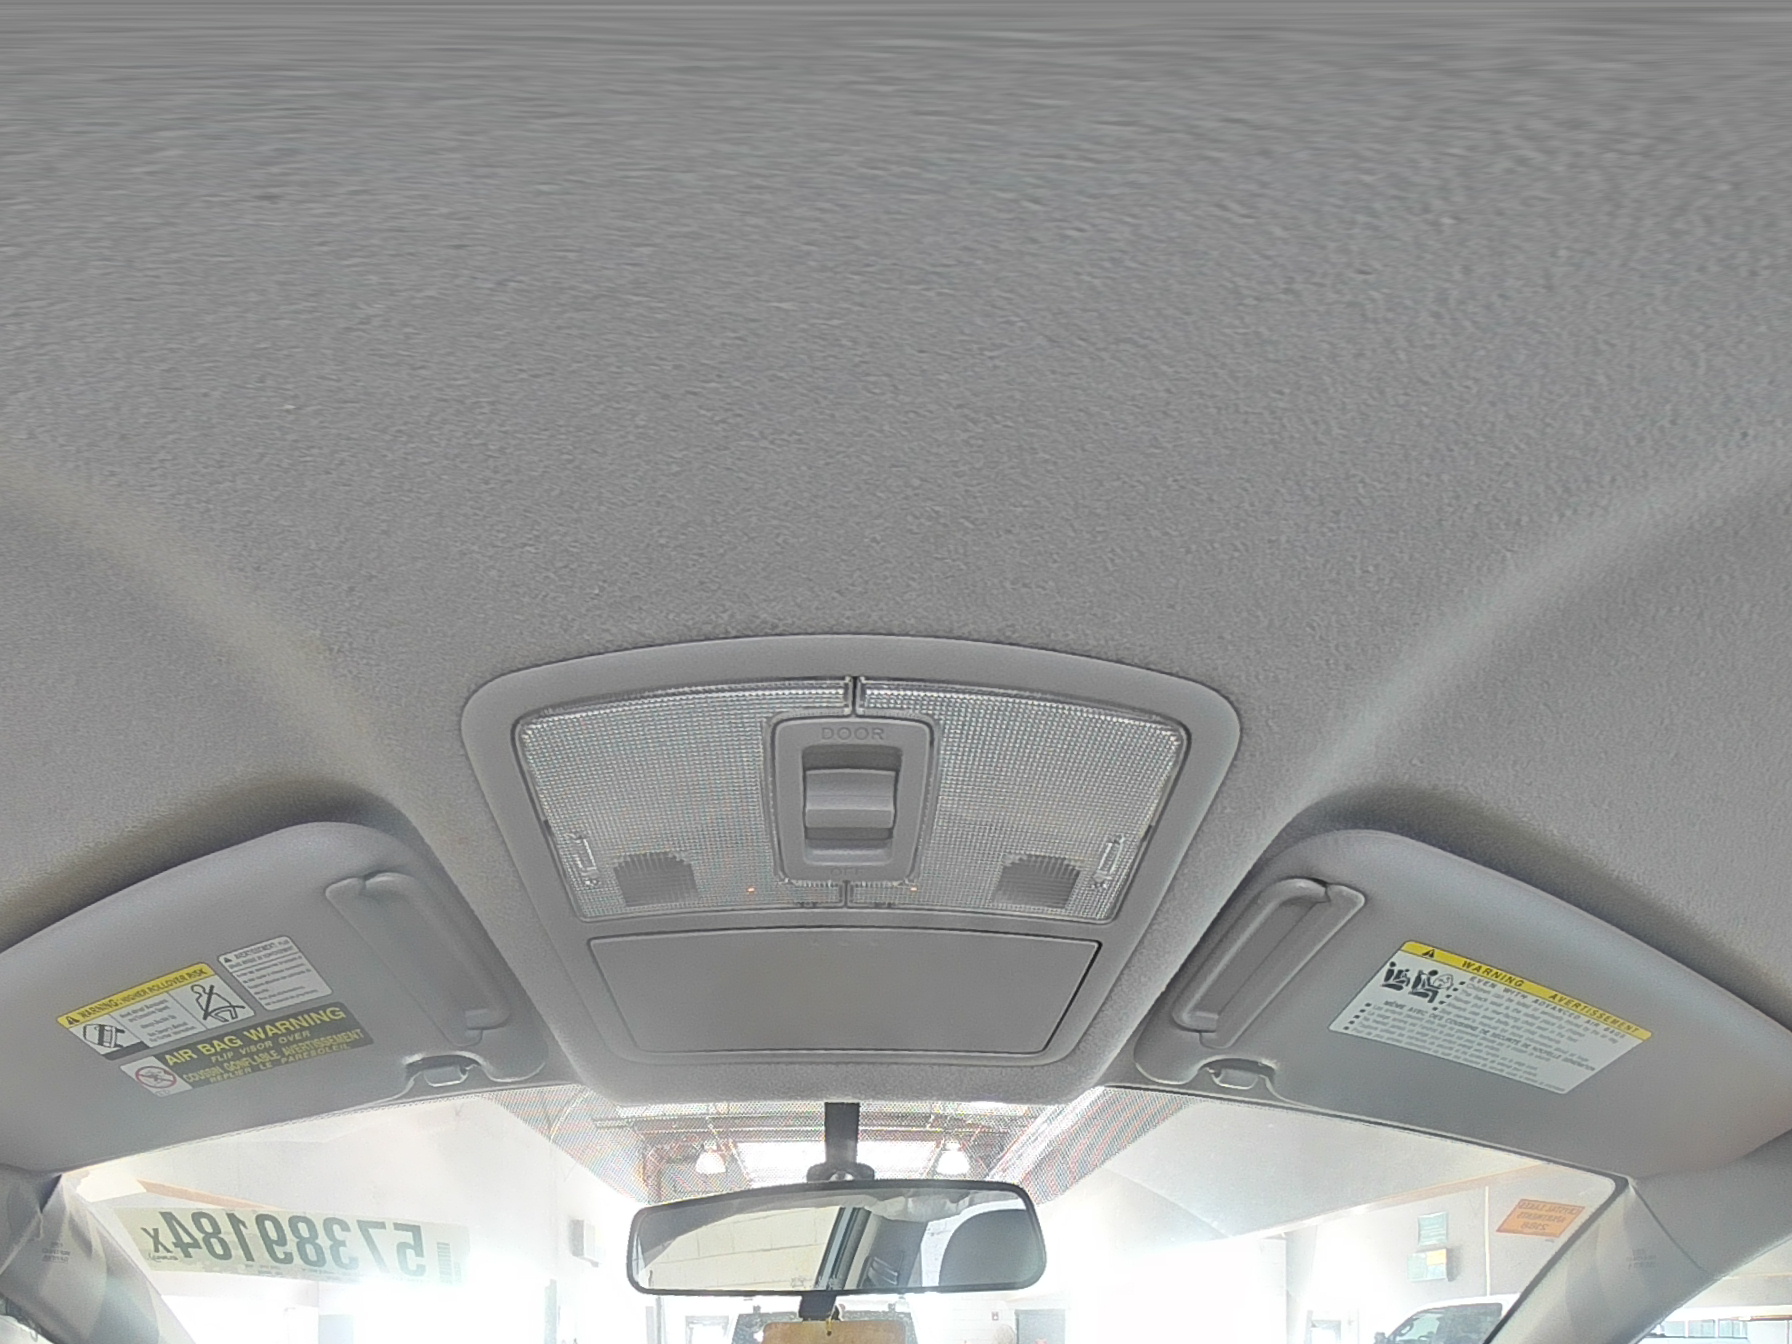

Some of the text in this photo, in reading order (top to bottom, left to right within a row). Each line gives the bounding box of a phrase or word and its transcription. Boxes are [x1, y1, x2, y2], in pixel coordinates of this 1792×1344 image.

[821, 726, 884, 740] DOOR
[1461, 960, 1525, 987] WARNING
[1548, 993, 1641, 1034] AVERTISSEMENT
[164, 1007, 346, 1067] AIR BAG WARNING
[211, 1031, 311, 1063] FLIP VISOR OVER
[282, 1028, 364, 1056] AVERTISSEMENT
